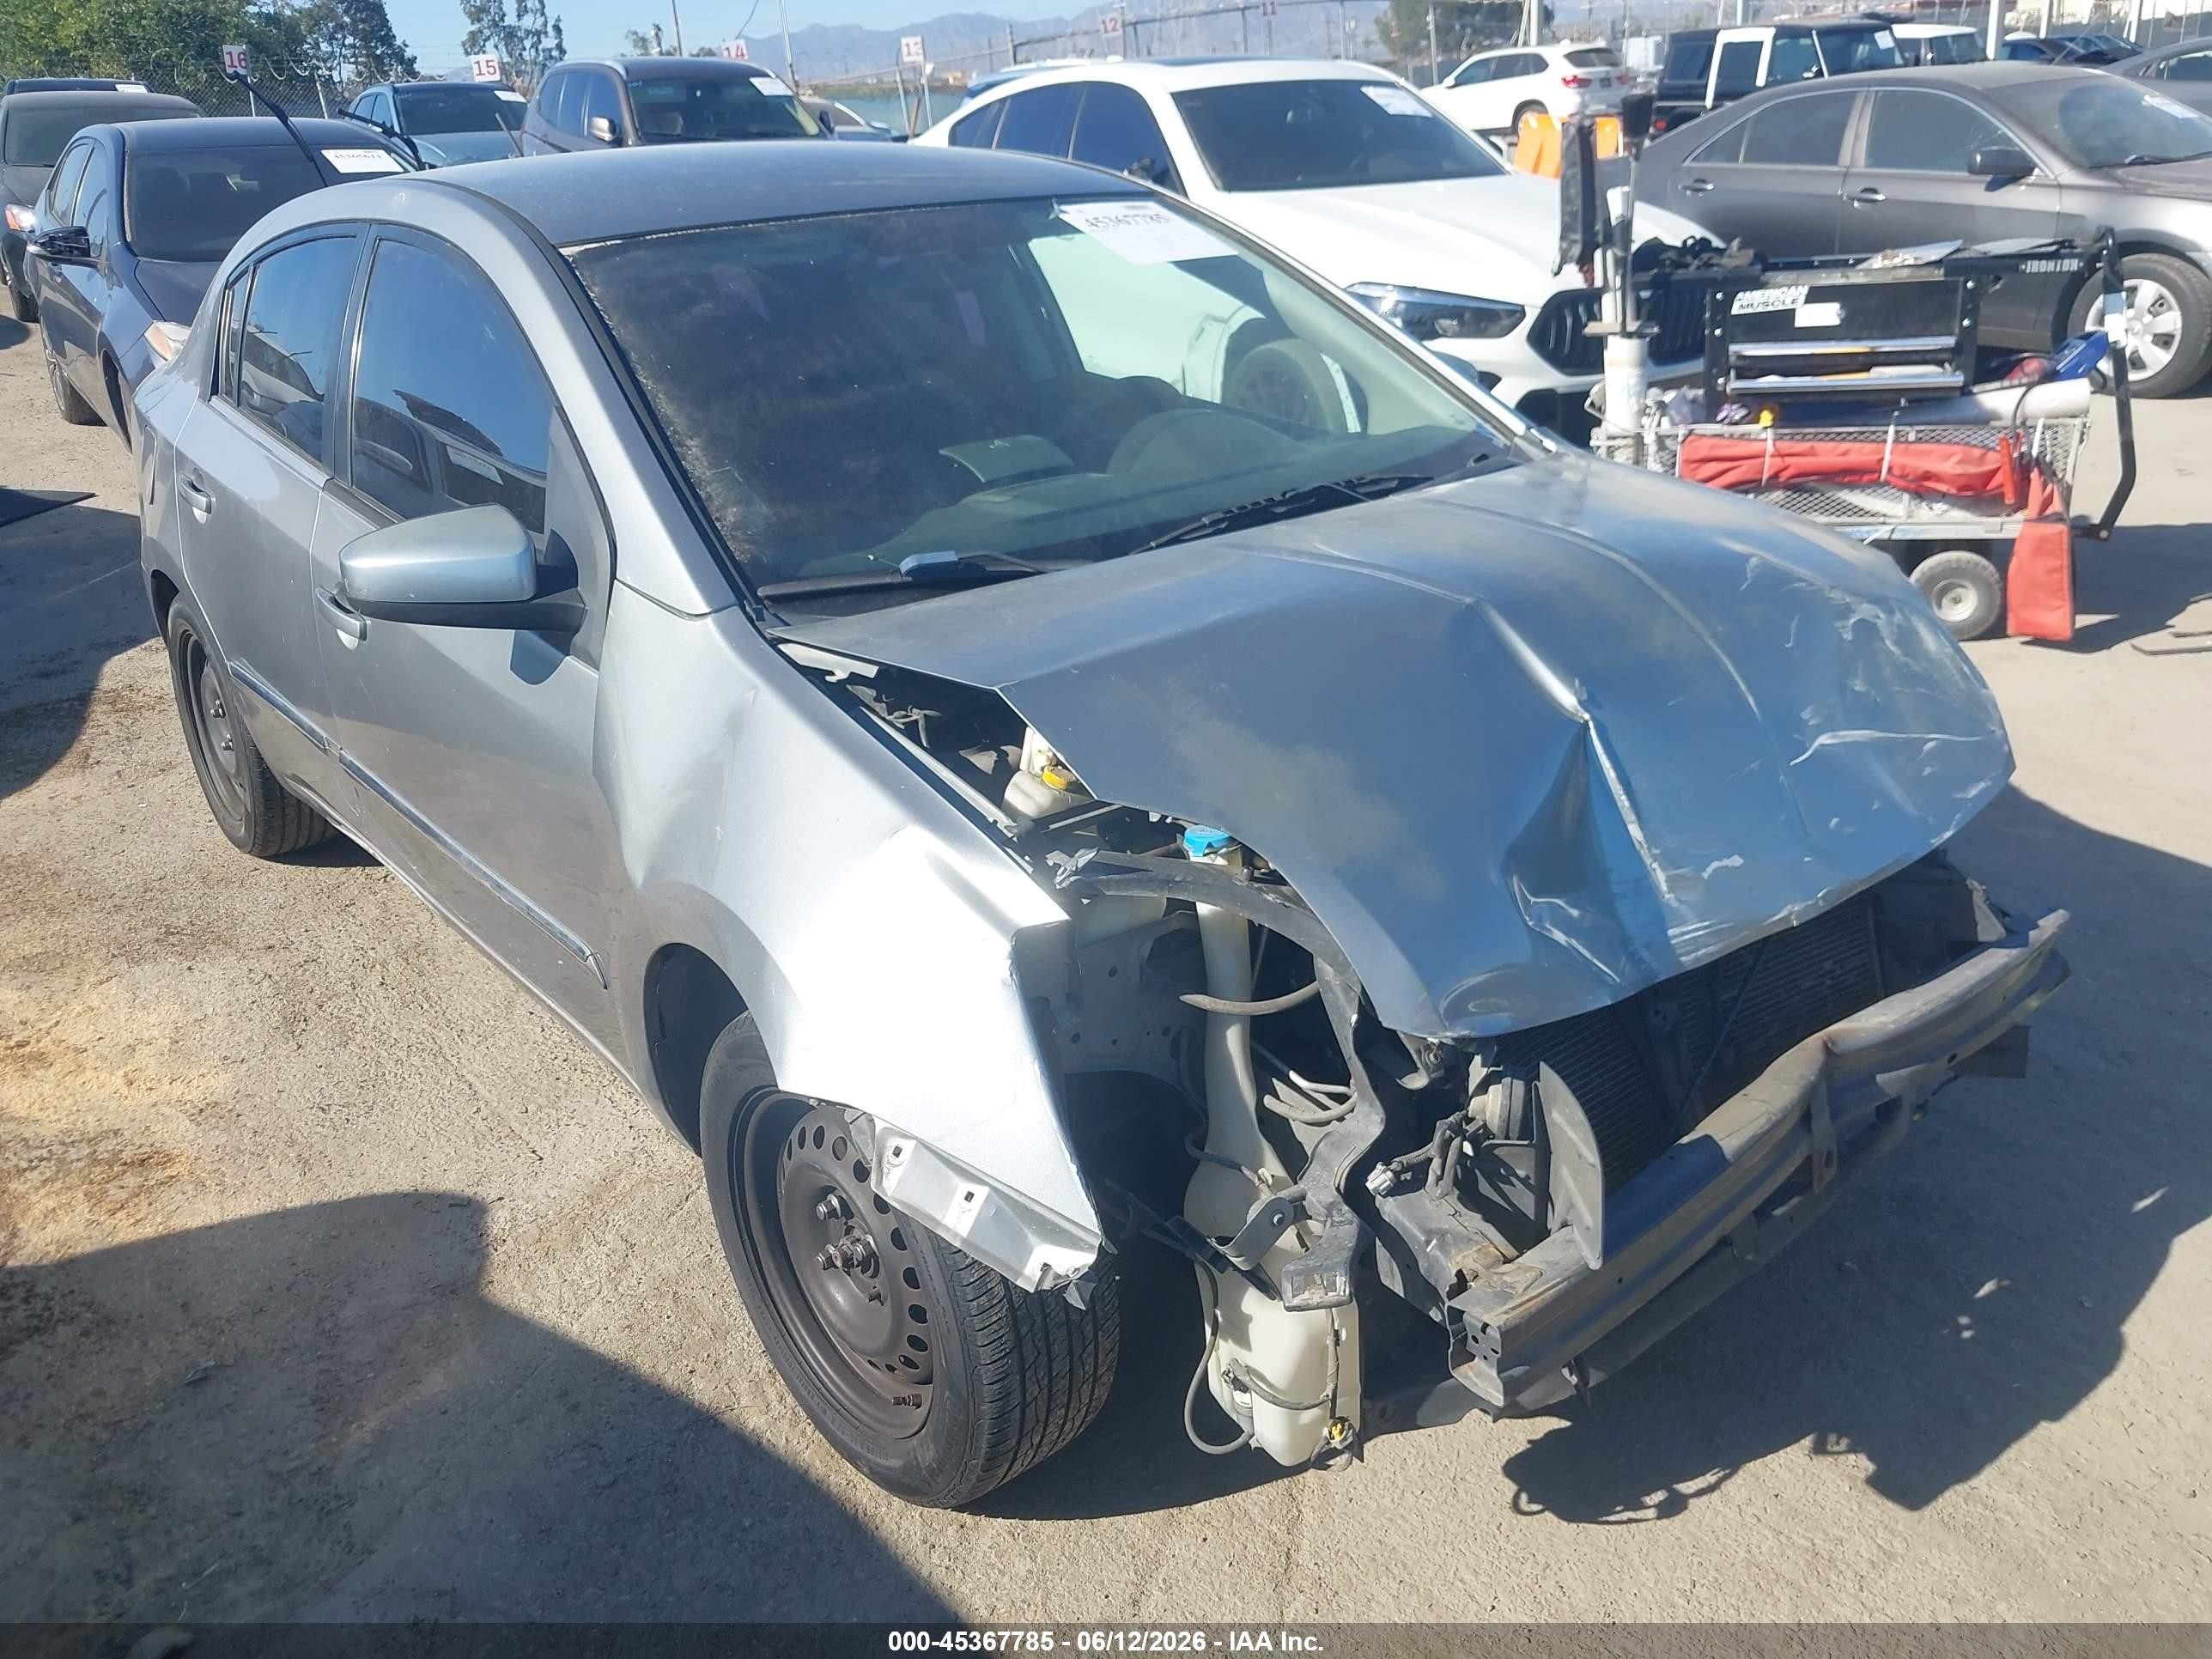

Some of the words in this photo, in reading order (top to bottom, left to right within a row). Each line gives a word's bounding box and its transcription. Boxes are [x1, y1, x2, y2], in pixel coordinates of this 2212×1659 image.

[1102, 17, 1119, 33] 12
[723, 44, 745, 59] 14
[225, 51, 247, 69] 16
[473, 59, 497, 76] 15
[1735, 285, 1809, 301] AMERICAN
[1737, 297, 1800, 310] MUSCLE
